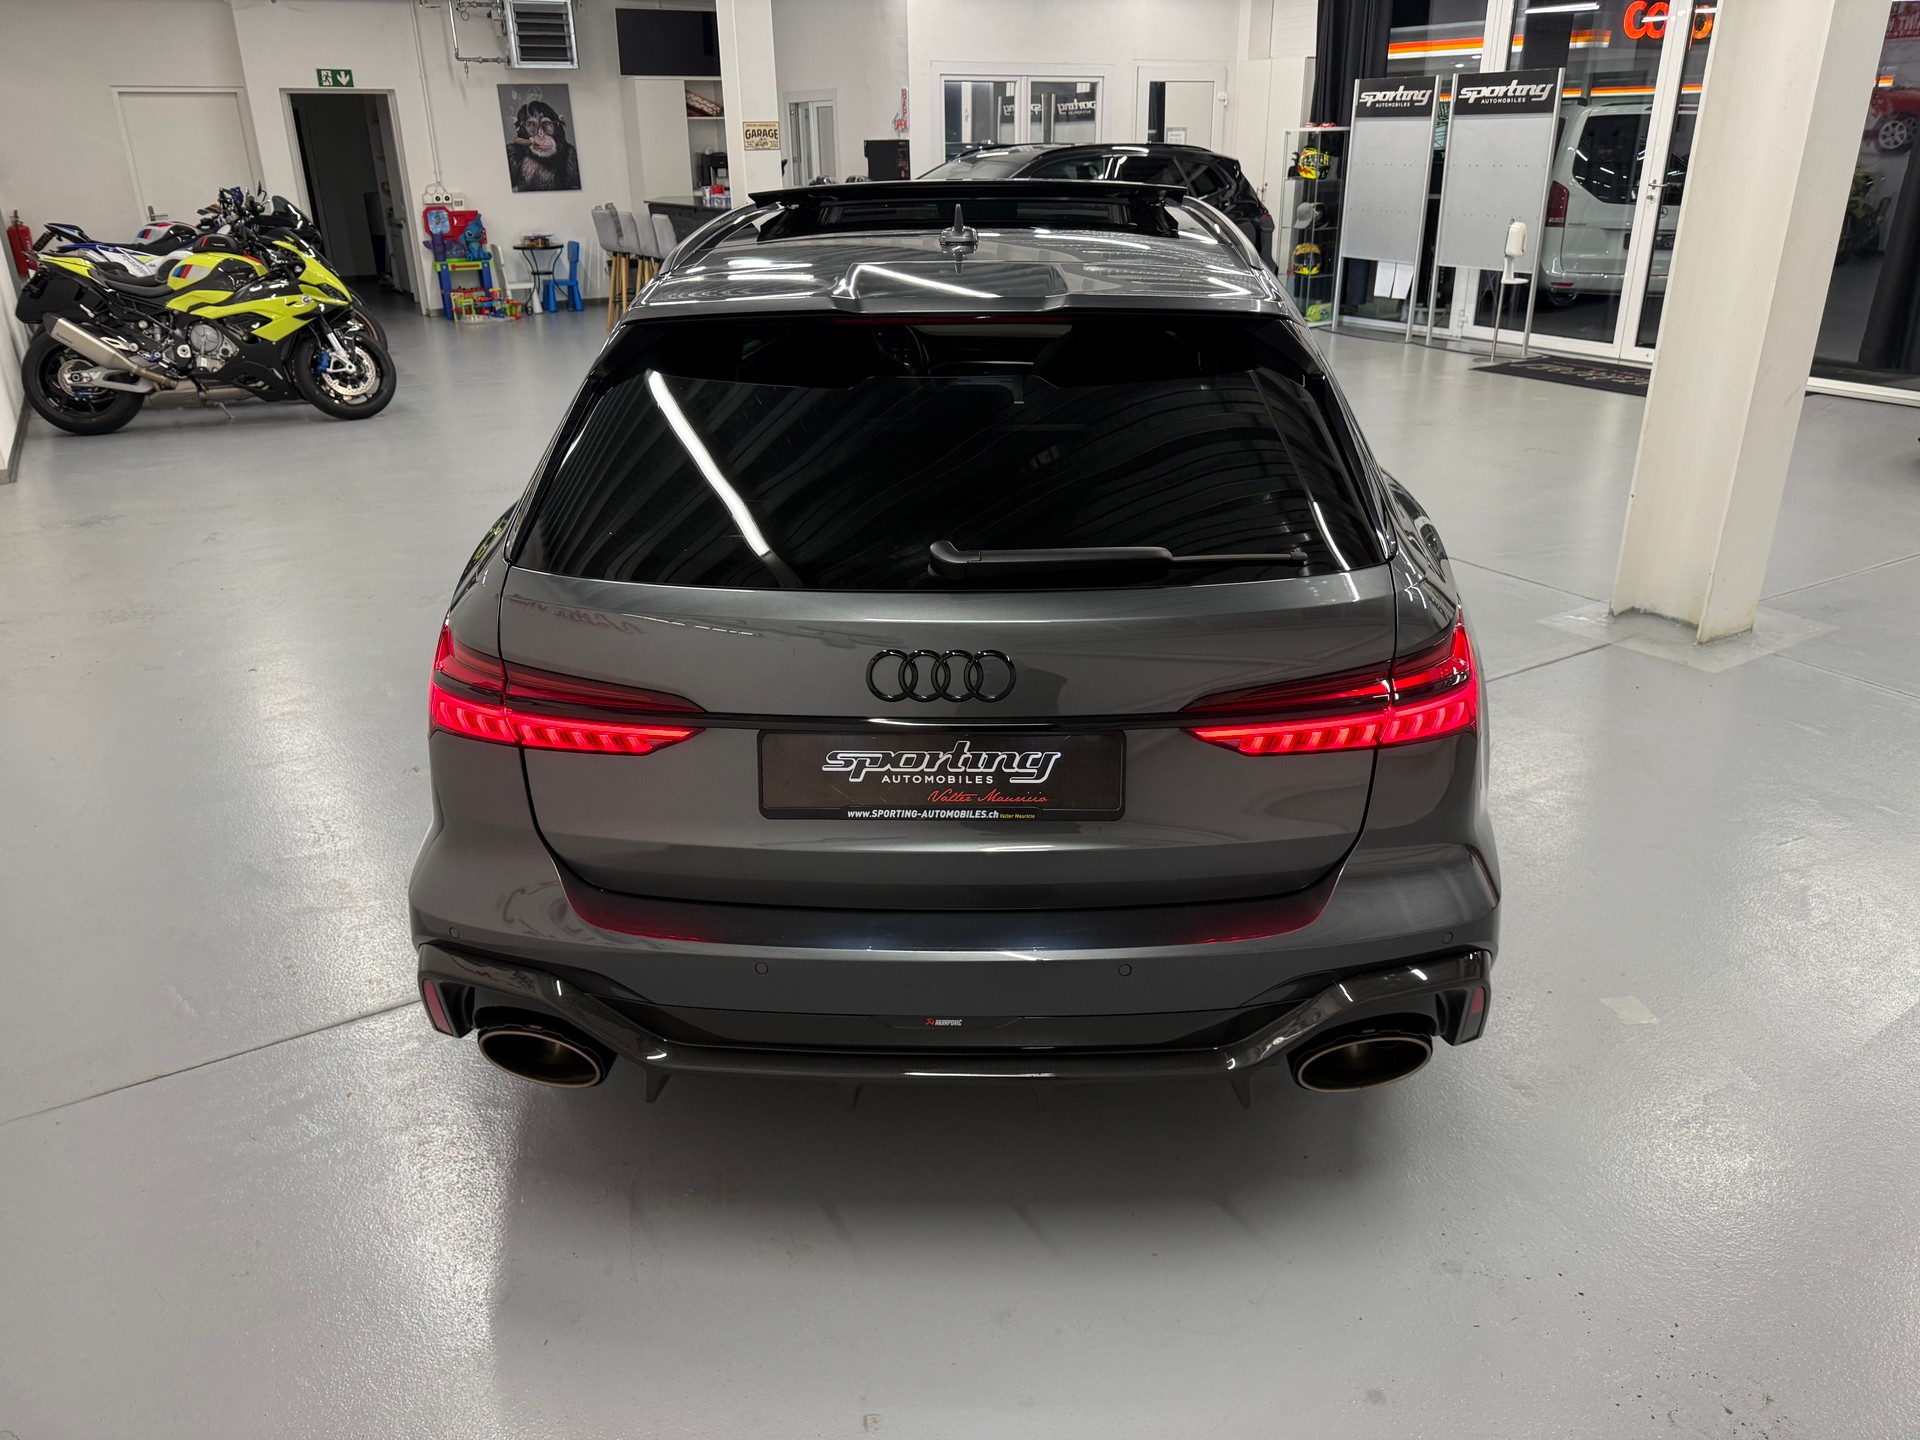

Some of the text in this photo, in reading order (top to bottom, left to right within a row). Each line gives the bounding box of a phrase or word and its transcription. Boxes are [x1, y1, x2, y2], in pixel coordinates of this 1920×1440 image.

[1623, 0, 1714, 50] cop
[1359, 85, 1432, 107] sporting
[1458, 79, 1554, 104] sporting
[1480, 97, 1526, 105] AUTOMOBILES
[745, 129, 779, 140] GARAGE
[822, 741, 1061, 784] sporting
[881, 775, 994, 784] AUTOMOBILES
[927, 788, 1048, 804] Valter Mauricio
[847, 809, 999, 819] www.SPORTING-AUTOMOBILES.ch
